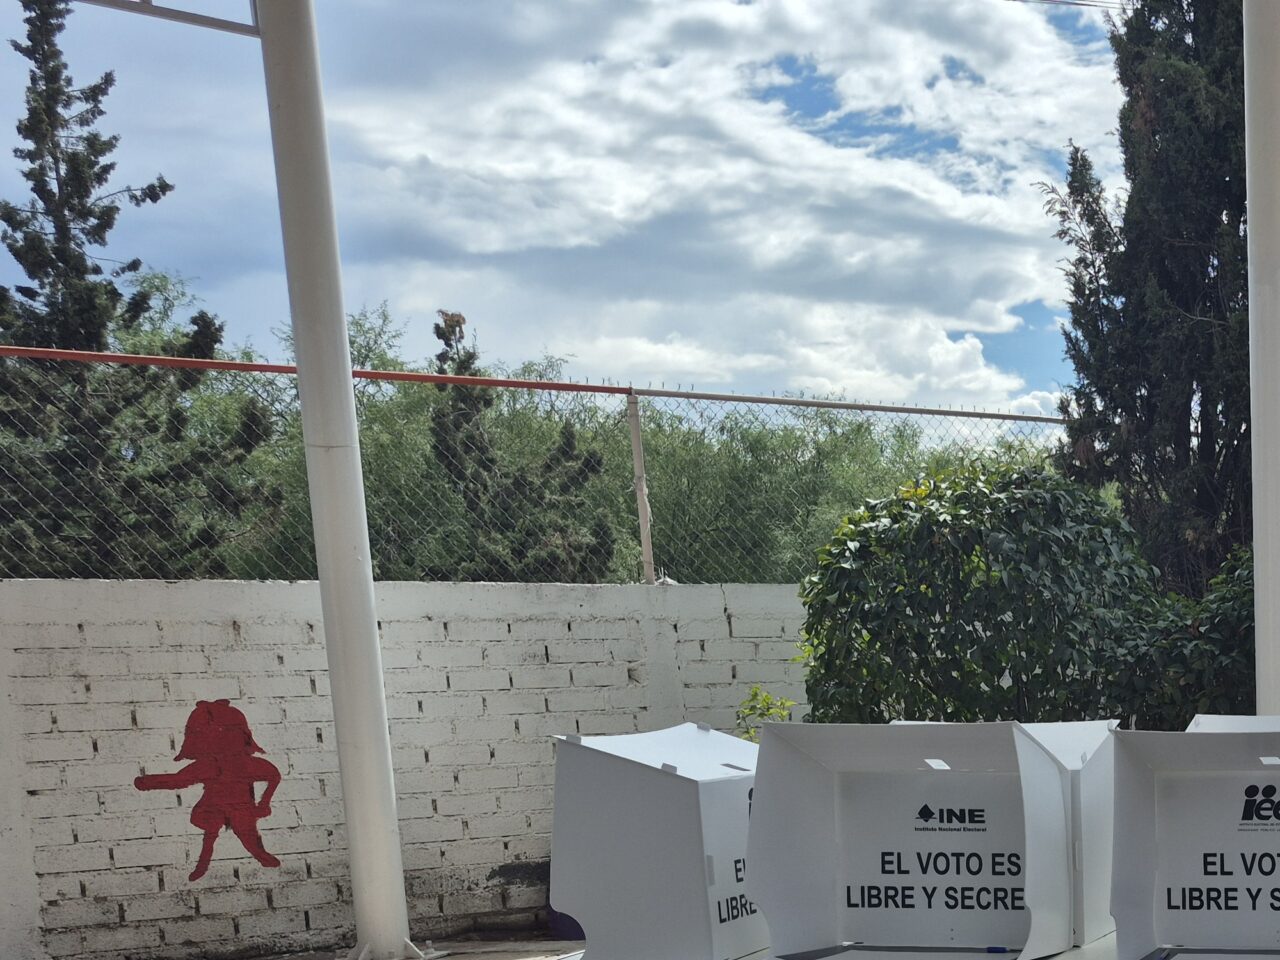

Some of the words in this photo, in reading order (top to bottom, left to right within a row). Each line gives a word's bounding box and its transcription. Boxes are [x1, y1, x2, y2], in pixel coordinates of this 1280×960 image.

[938, 808, 986, 824] INE
[880, 852, 910, 875] EL
[916, 852, 982, 876] VOTO
[991, 852, 1022, 876] ES
[1202, 852, 1232, 876] EL
[846, 885, 914, 909] LIBRE
[920, 886, 938, 909] Y
[944, 886, 1024, 911] SECRE
[1166, 886, 1238, 911] LIBRE
[1245, 886, 1262, 910] Y
